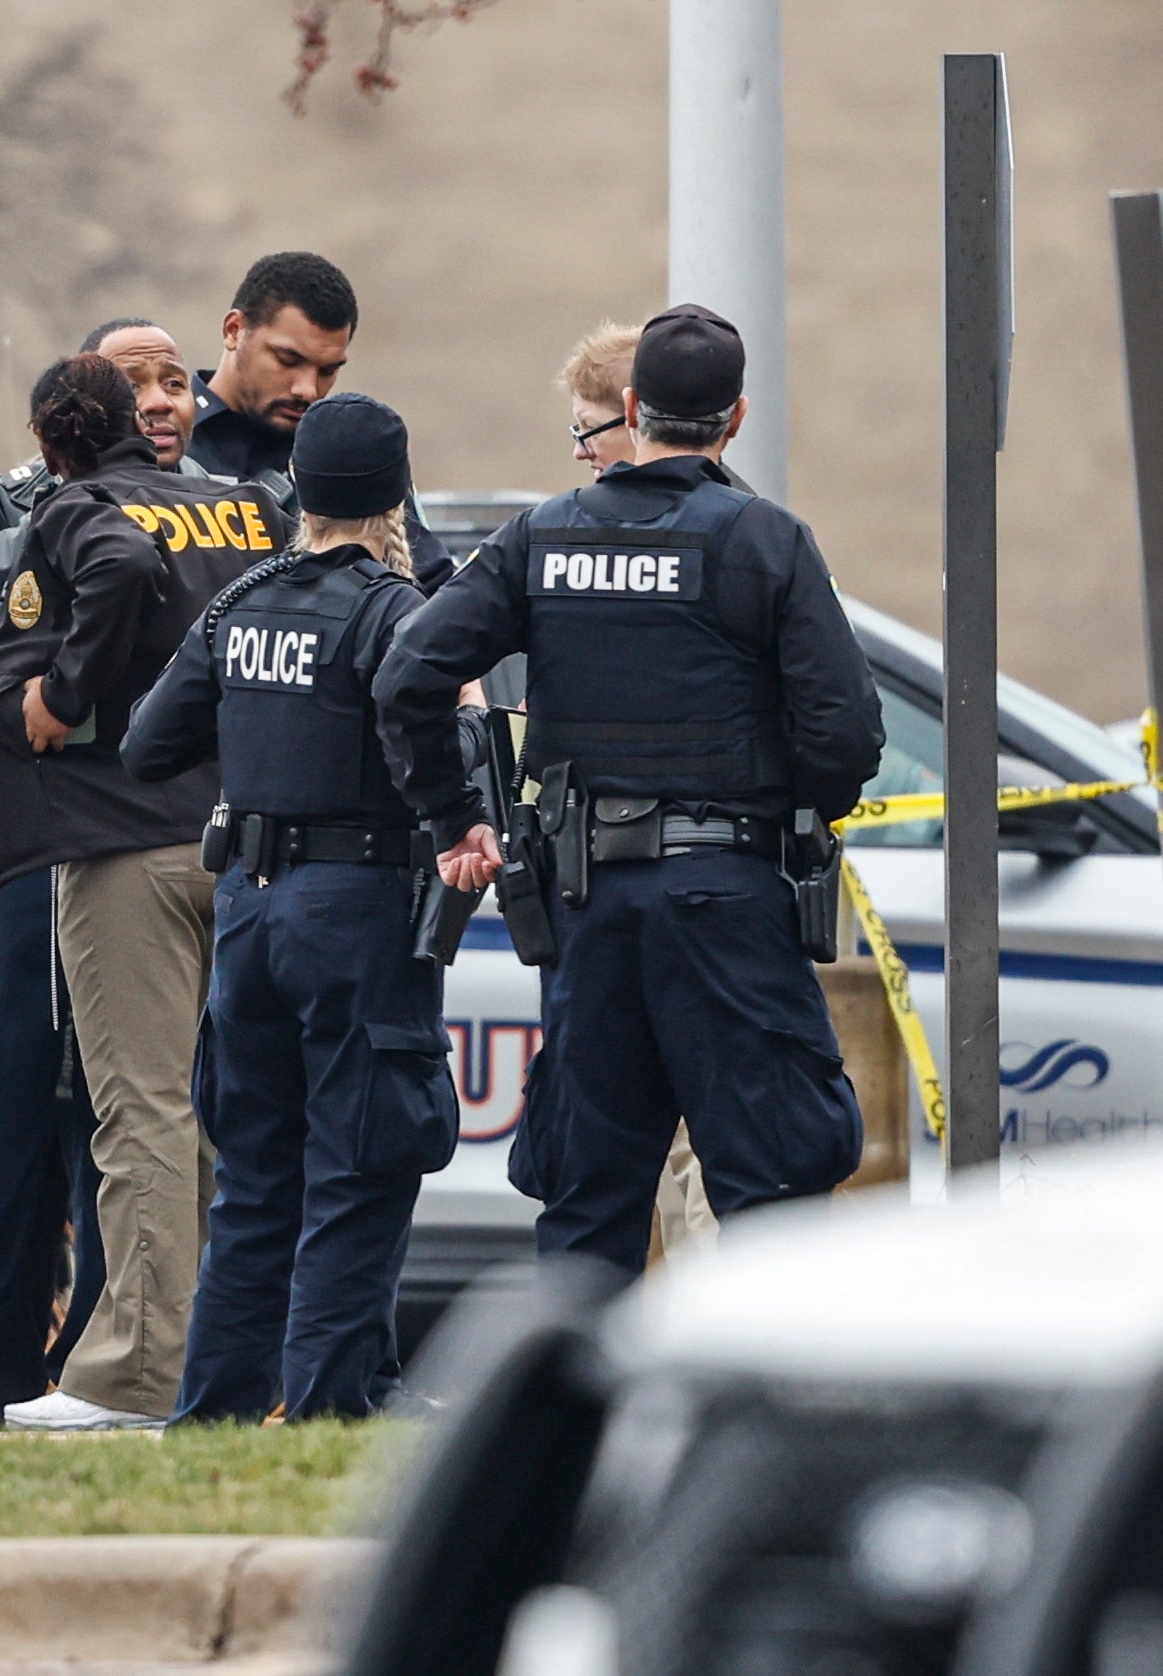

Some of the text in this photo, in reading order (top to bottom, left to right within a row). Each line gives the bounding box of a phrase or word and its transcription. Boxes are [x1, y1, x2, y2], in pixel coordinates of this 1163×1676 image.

[120, 500, 273, 552] POLICE
[541, 552, 680, 592] POLICE
[226, 626, 317, 686] POLICE
